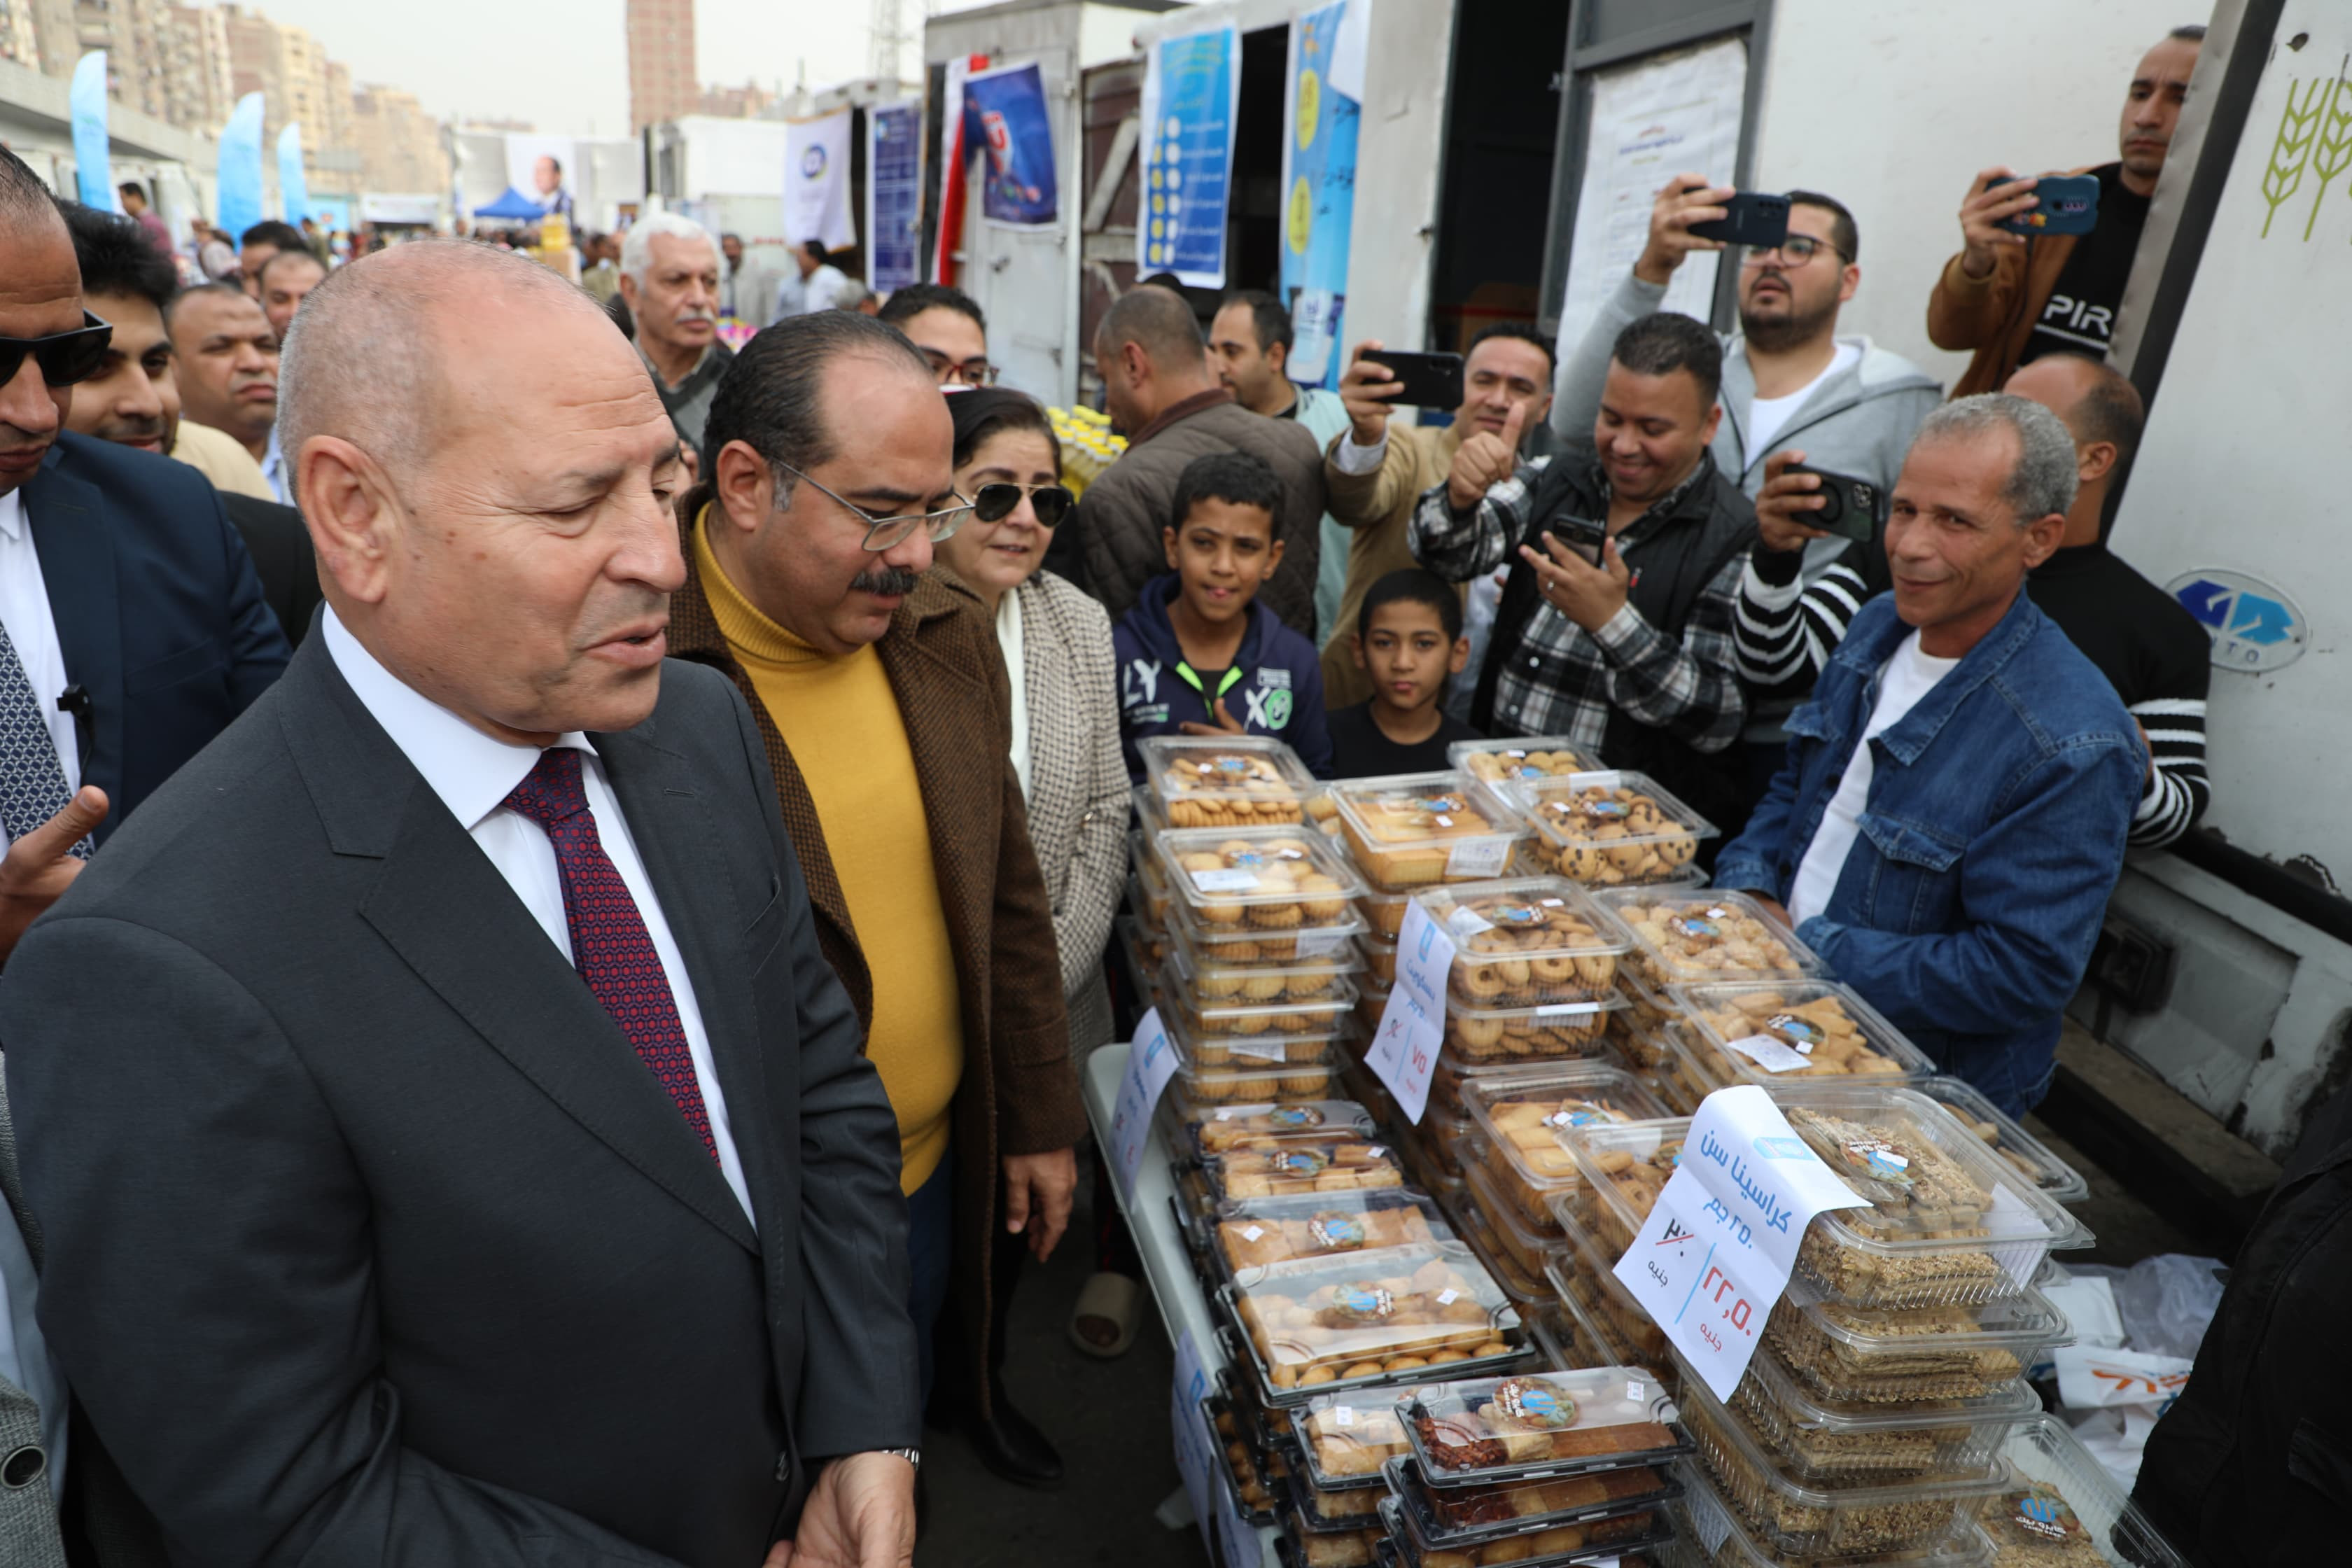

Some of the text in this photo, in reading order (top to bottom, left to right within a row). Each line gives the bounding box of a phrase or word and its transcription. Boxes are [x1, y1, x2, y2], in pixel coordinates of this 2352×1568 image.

[2043, 294, 2113, 336] PIR
[1700, 1129, 1793, 1234] كراسينا سن
[1703, 1196, 1753, 1250] ٢٥٠ جم
[1647, 1259, 1669, 1288] جنيه
[1700, 1322, 1723, 1352] جنيه
